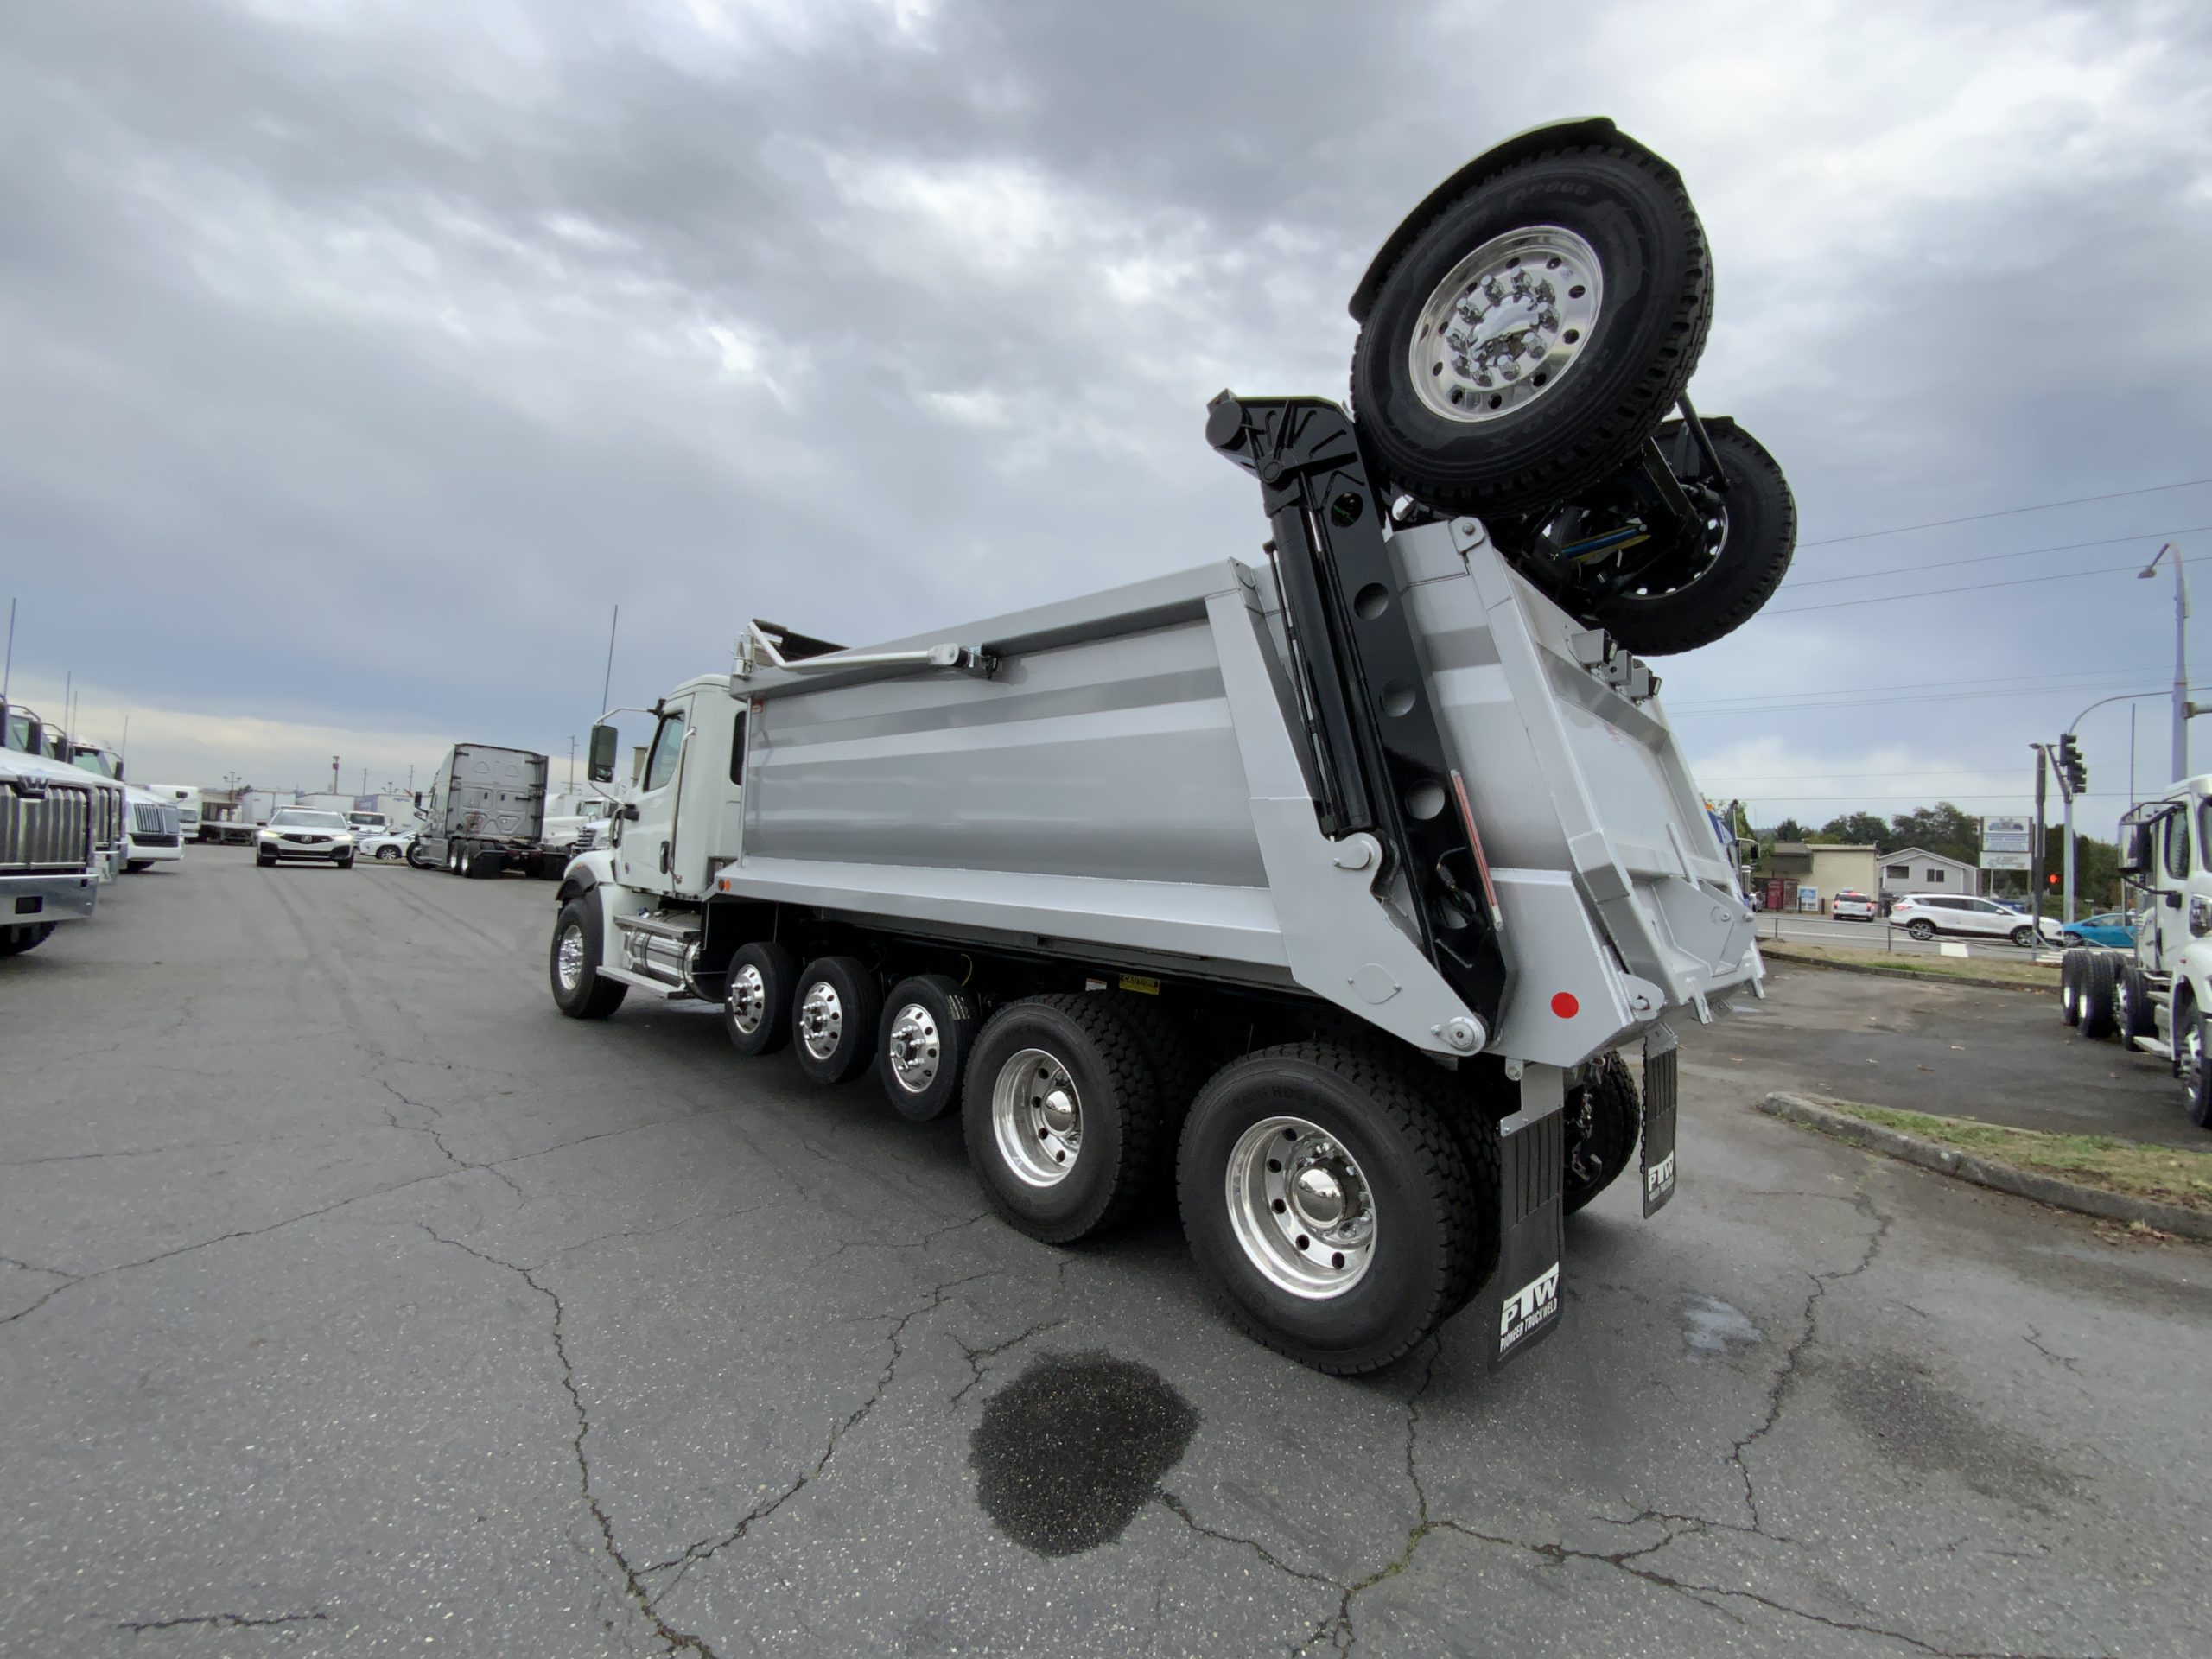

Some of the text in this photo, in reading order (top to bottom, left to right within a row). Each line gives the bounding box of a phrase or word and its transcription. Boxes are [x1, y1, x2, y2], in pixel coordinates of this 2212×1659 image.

[1122, 975, 1155, 987] CAUTION
[1649, 1151, 1674, 1192] PTW
[1500, 1261, 1559, 1336] PTW
[1499, 1297, 1558, 1353] PIONEER TRUCKWELD
